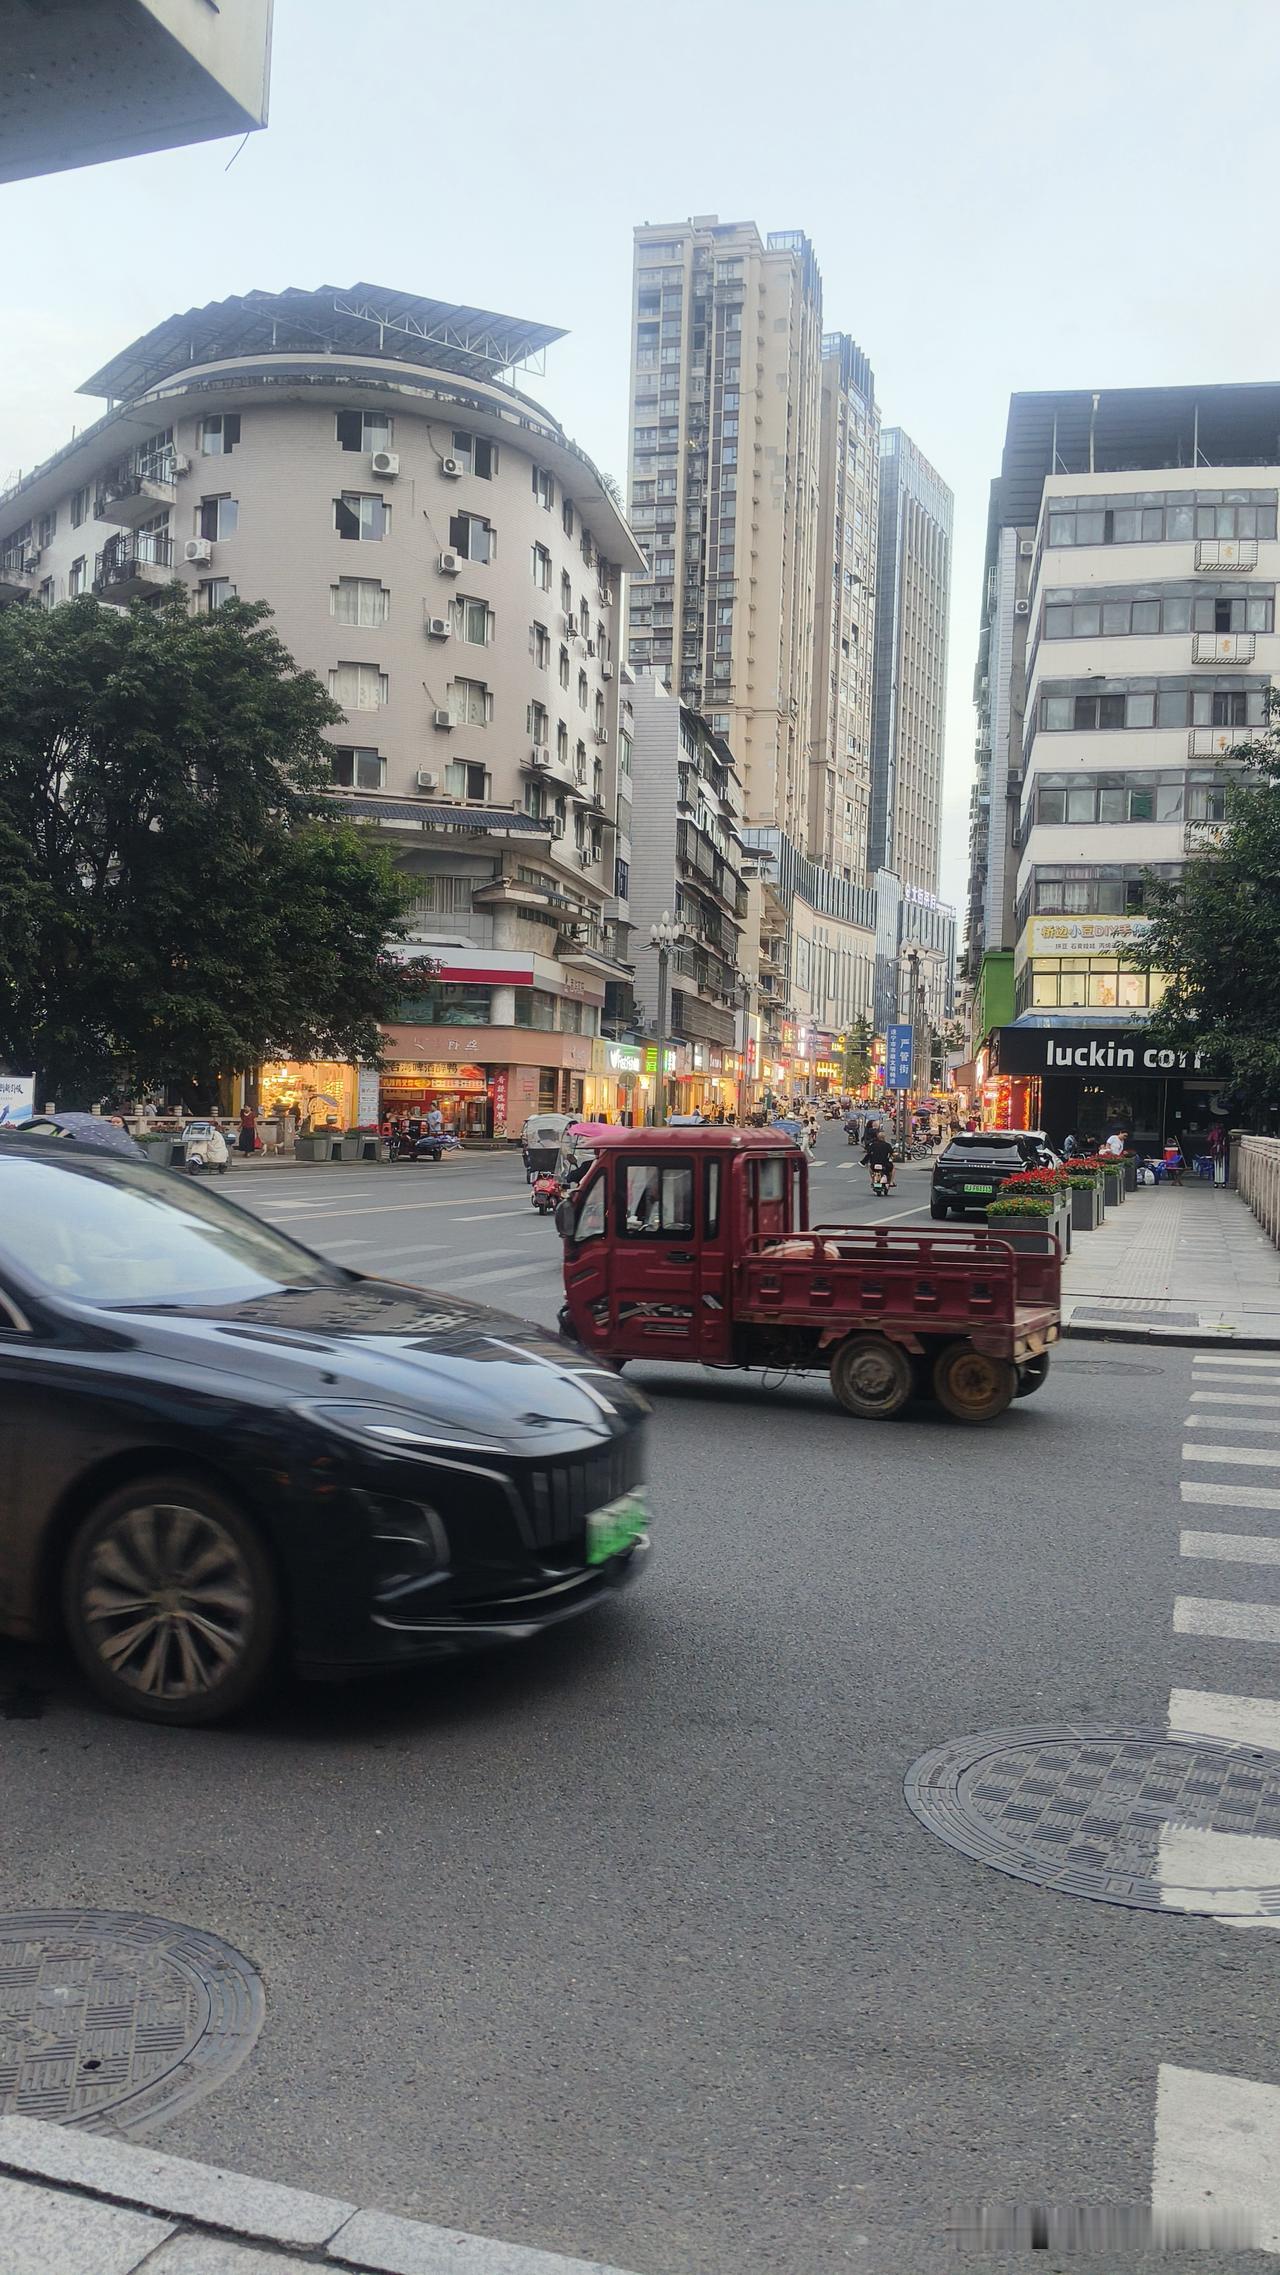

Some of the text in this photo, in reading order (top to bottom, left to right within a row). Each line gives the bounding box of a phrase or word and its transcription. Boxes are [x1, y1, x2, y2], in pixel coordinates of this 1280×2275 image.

[899, 1038, 910, 1075] 严管街
[1046, 1040, 1134, 1068] luckin
